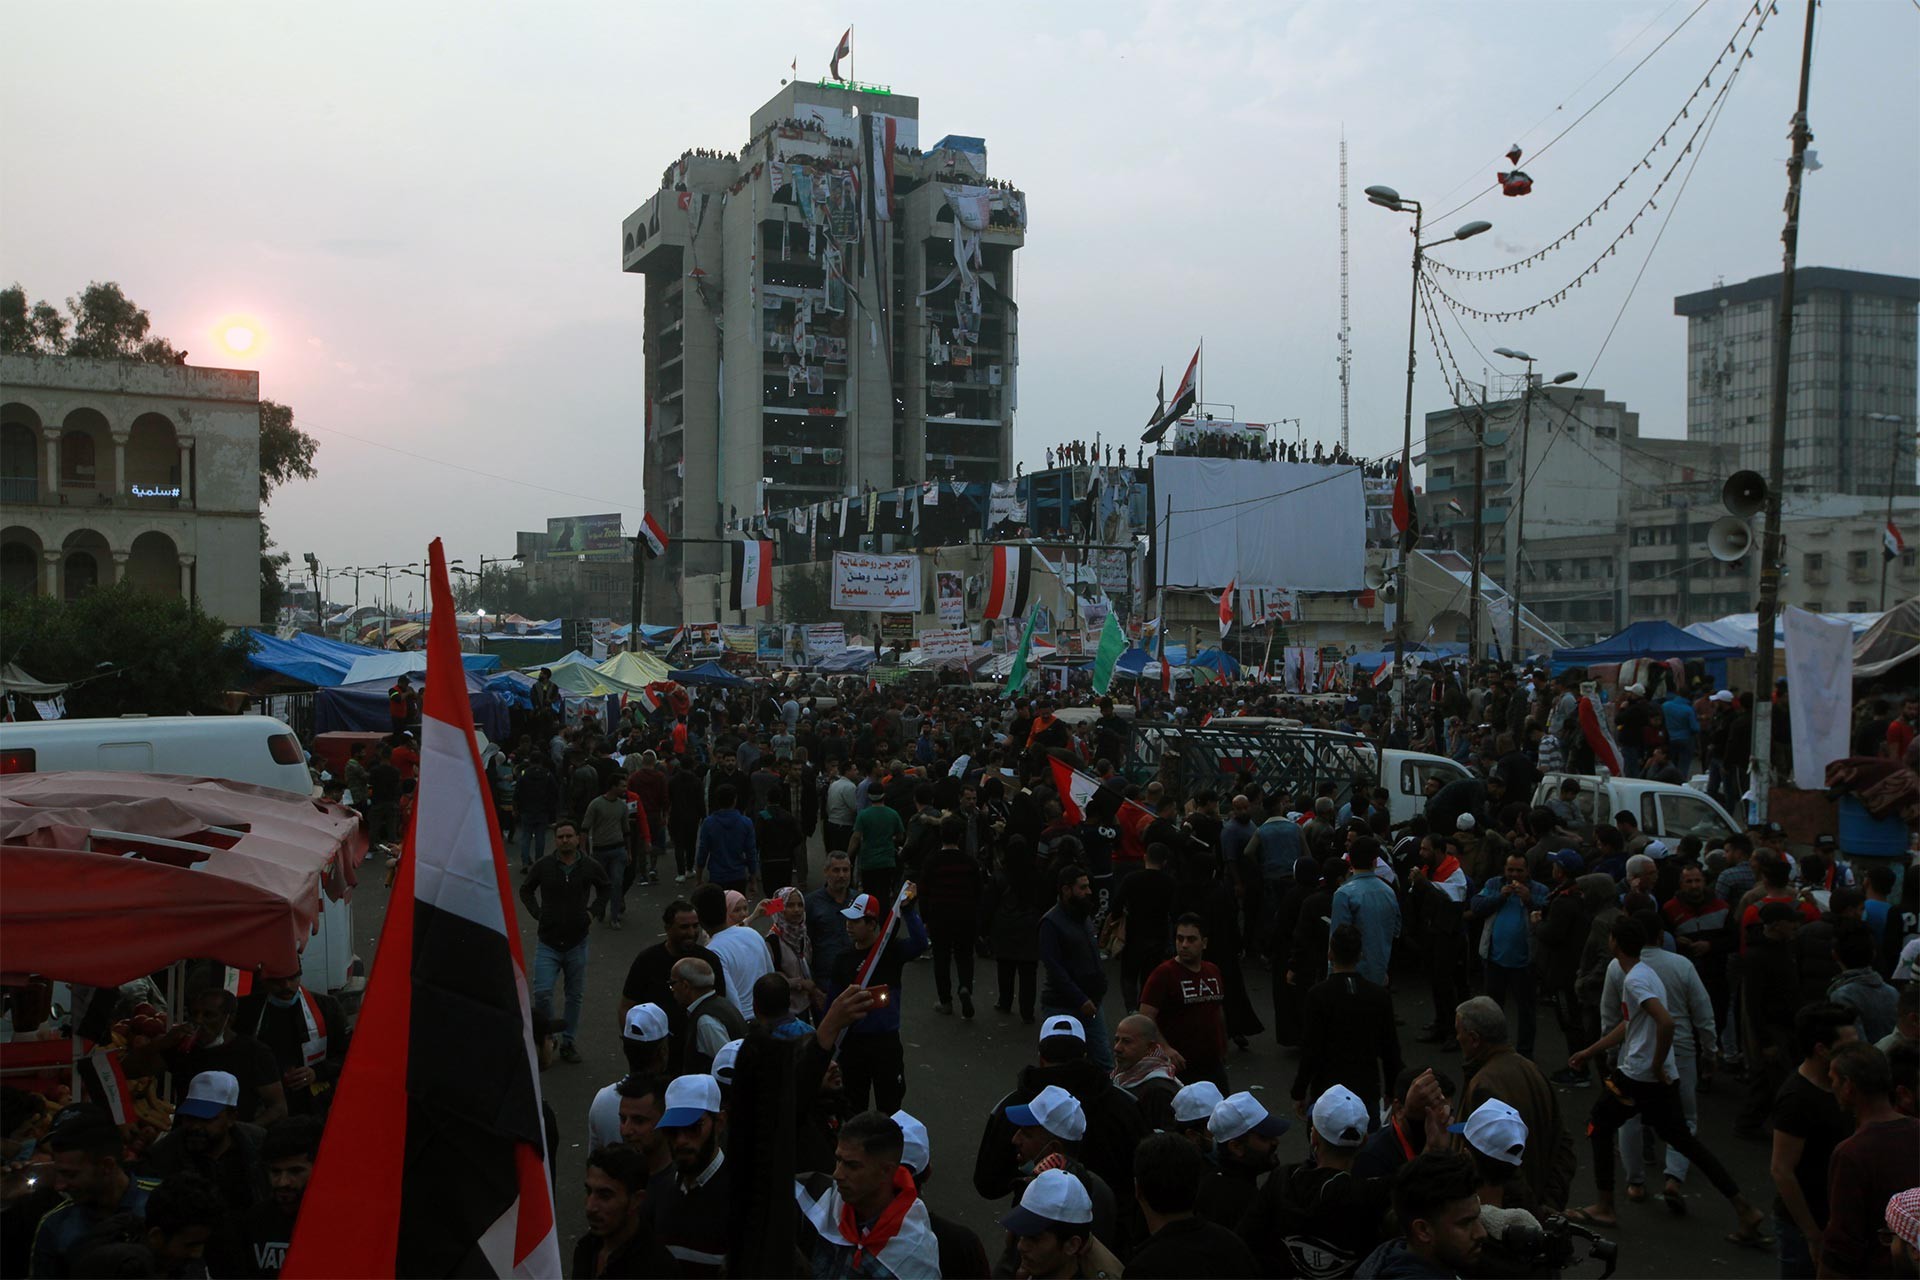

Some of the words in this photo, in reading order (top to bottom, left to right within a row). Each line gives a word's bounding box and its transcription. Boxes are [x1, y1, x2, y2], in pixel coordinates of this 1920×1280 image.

[131, 484, 180, 498] #سلمية
[847, 572, 870, 583] وطن
[874, 573, 899, 583] نريد
[884, 586, 910, 599] سلمية
[1180, 977, 1220, 998] EA7
